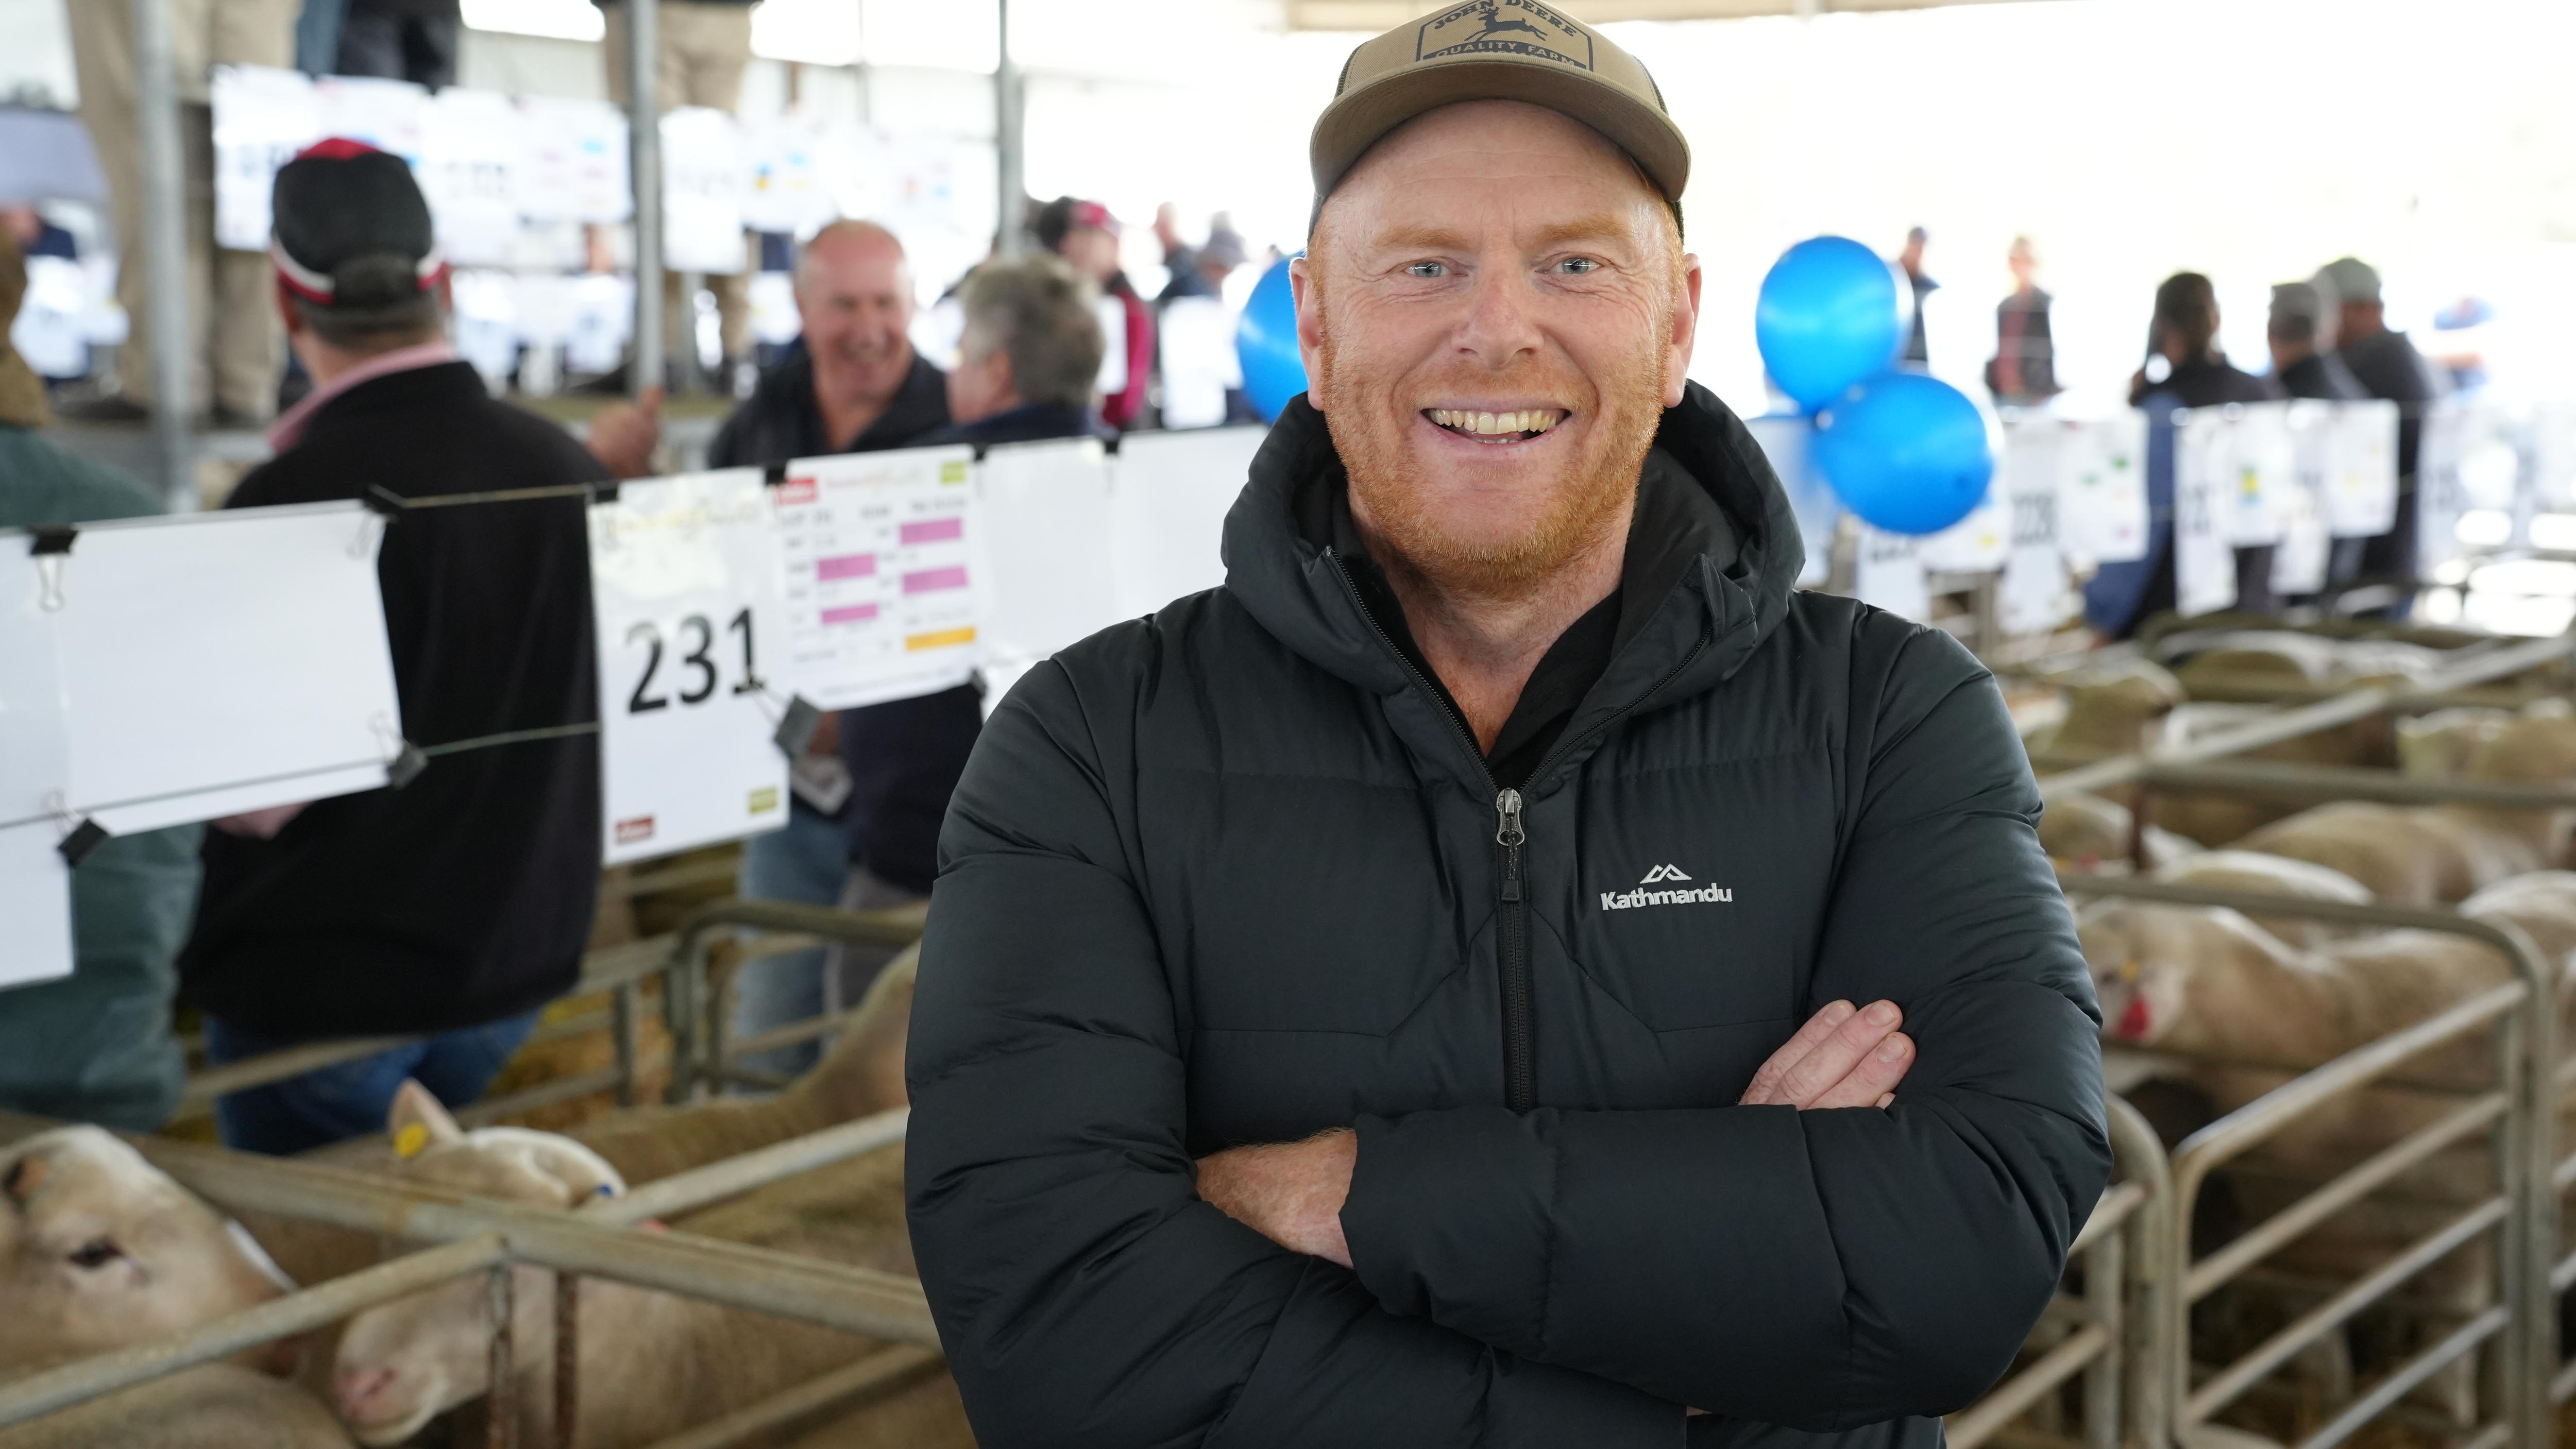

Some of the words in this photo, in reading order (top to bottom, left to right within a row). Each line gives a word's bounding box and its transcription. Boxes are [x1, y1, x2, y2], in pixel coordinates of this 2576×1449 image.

[1435, 0, 1494, 29] JOHN
[1505, 0, 1577, 37] DEERE
[1528, 45, 1575, 65] FARM
[625, 607, 765, 713] 231
[1600, 882, 1733, 911] Kathmandu
